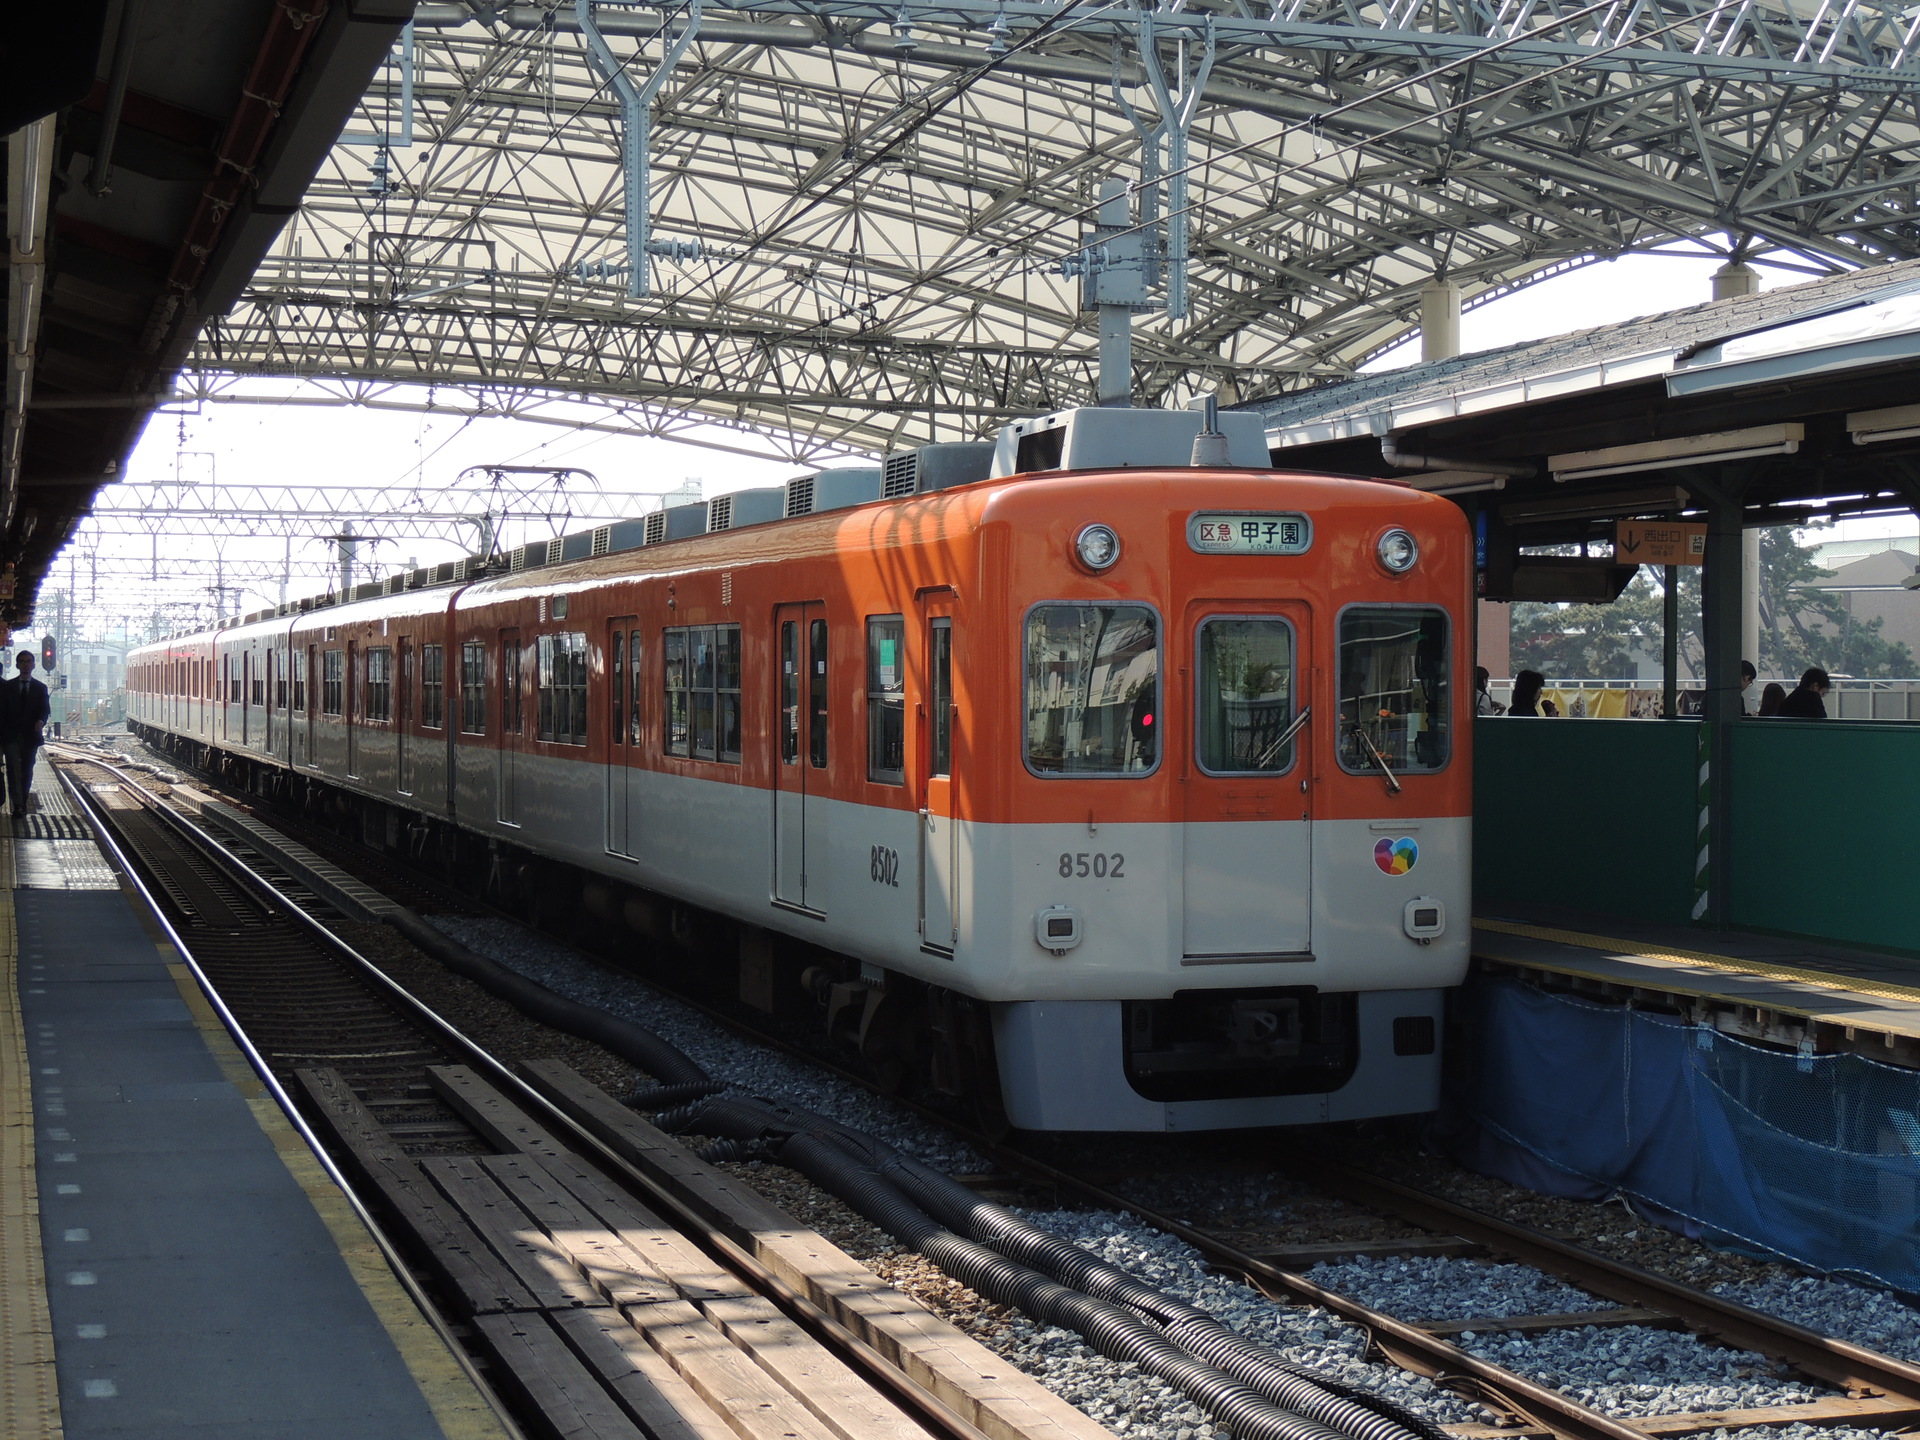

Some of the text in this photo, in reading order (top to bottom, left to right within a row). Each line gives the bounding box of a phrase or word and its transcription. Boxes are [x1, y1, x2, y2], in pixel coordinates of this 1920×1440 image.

[1200, 521, 1299, 545] 区急 甲子園
[1644, 529, 1681, 543] 西出口
[871, 844, 899, 888] 8502
[1058, 852, 1125, 878] 8502
